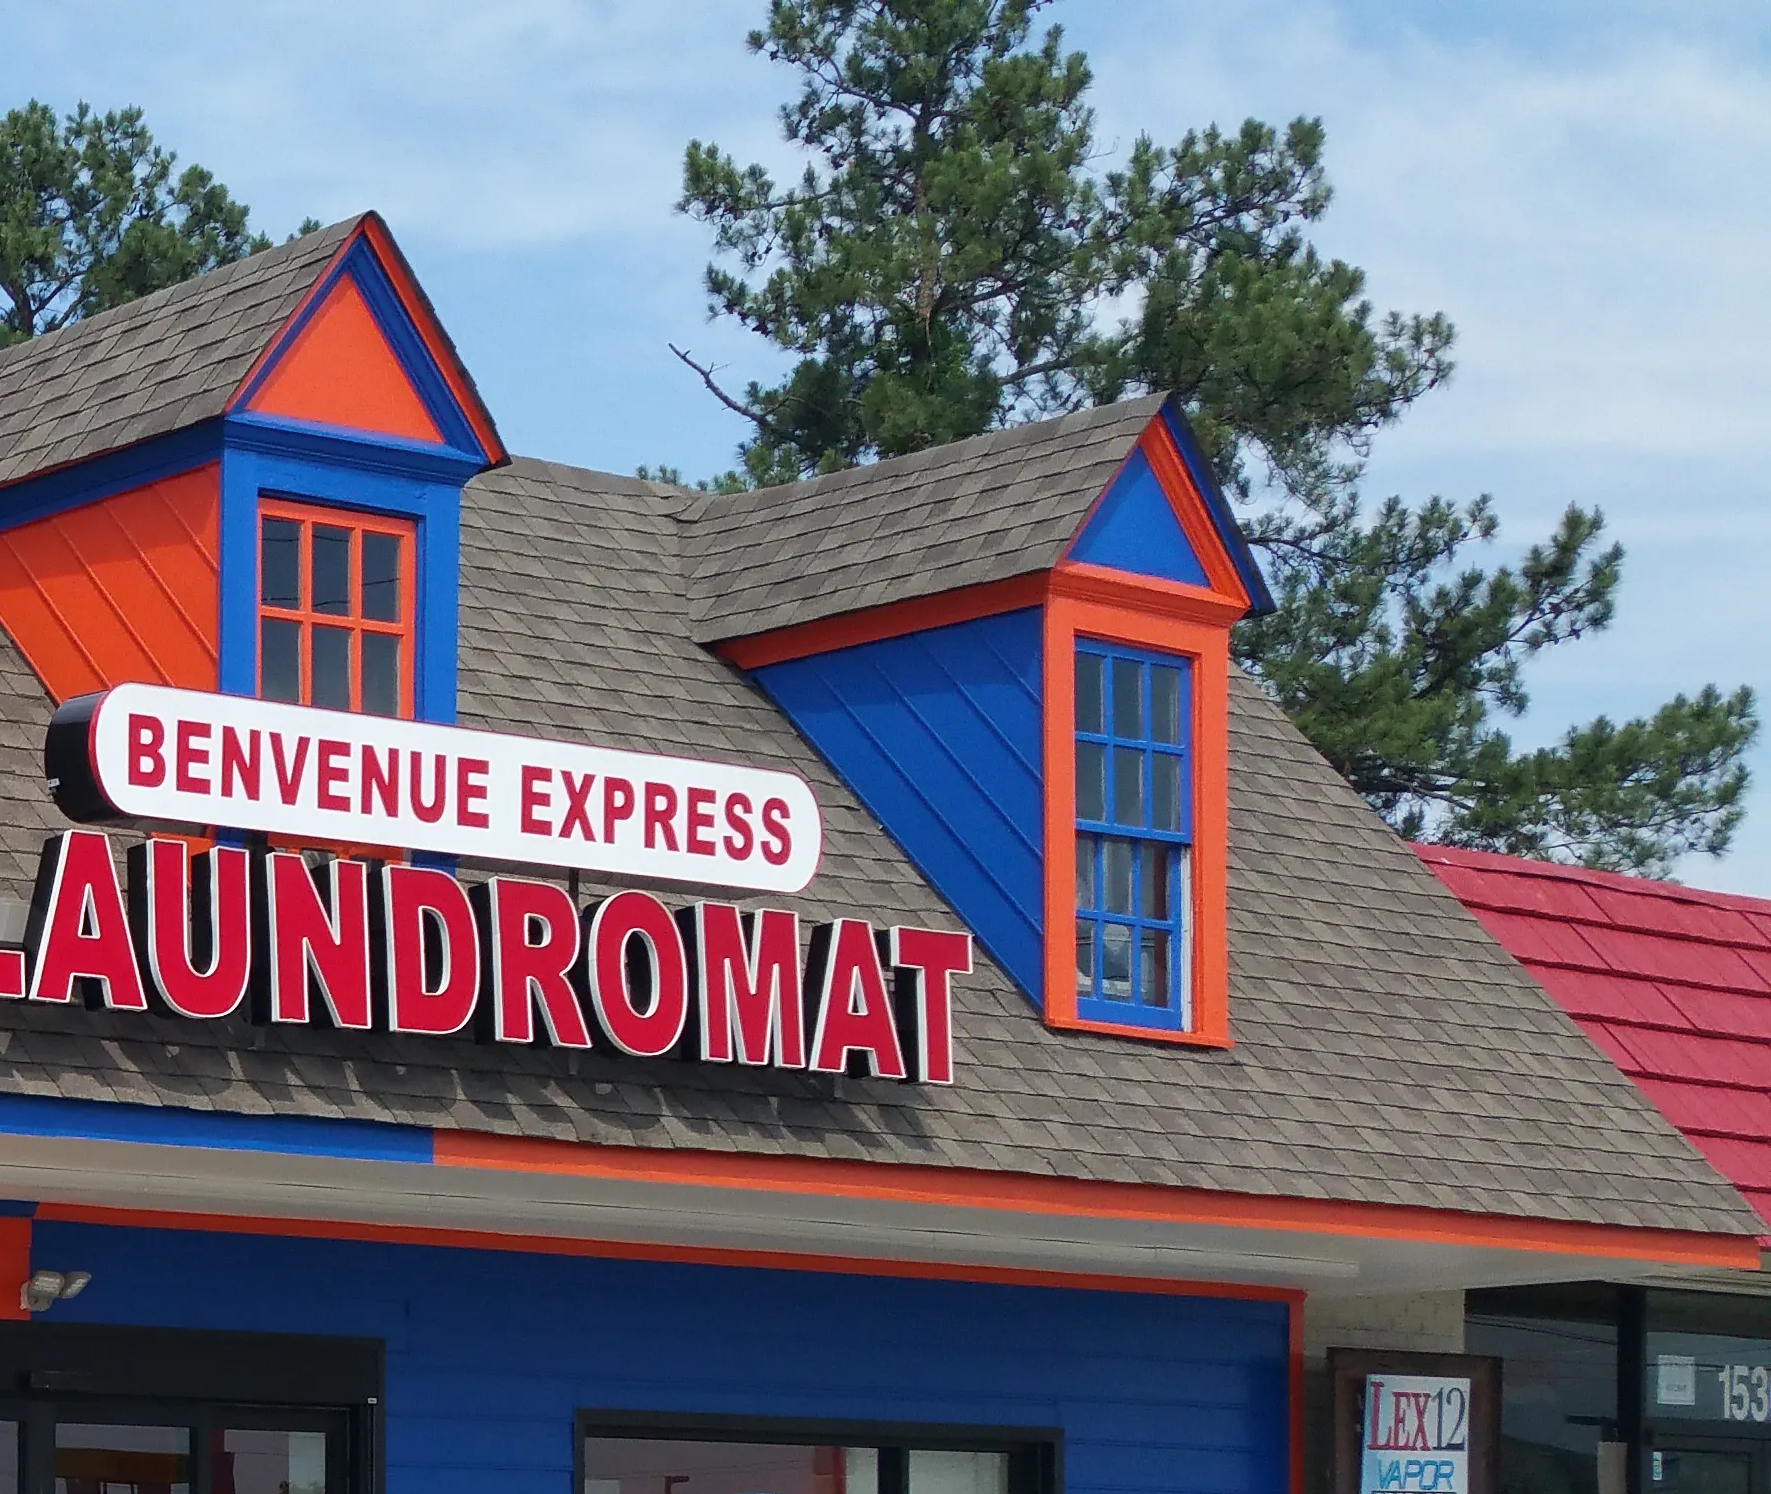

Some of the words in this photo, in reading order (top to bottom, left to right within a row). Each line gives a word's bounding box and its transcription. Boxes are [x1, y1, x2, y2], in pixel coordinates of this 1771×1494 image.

[128, 712, 490, 829] BENVENUE
[520, 763, 793, 868] EXPRESS
[1367, 1381, 1466, 1452] LEX12
[1377, 1459, 1455, 1491] VAPOR
